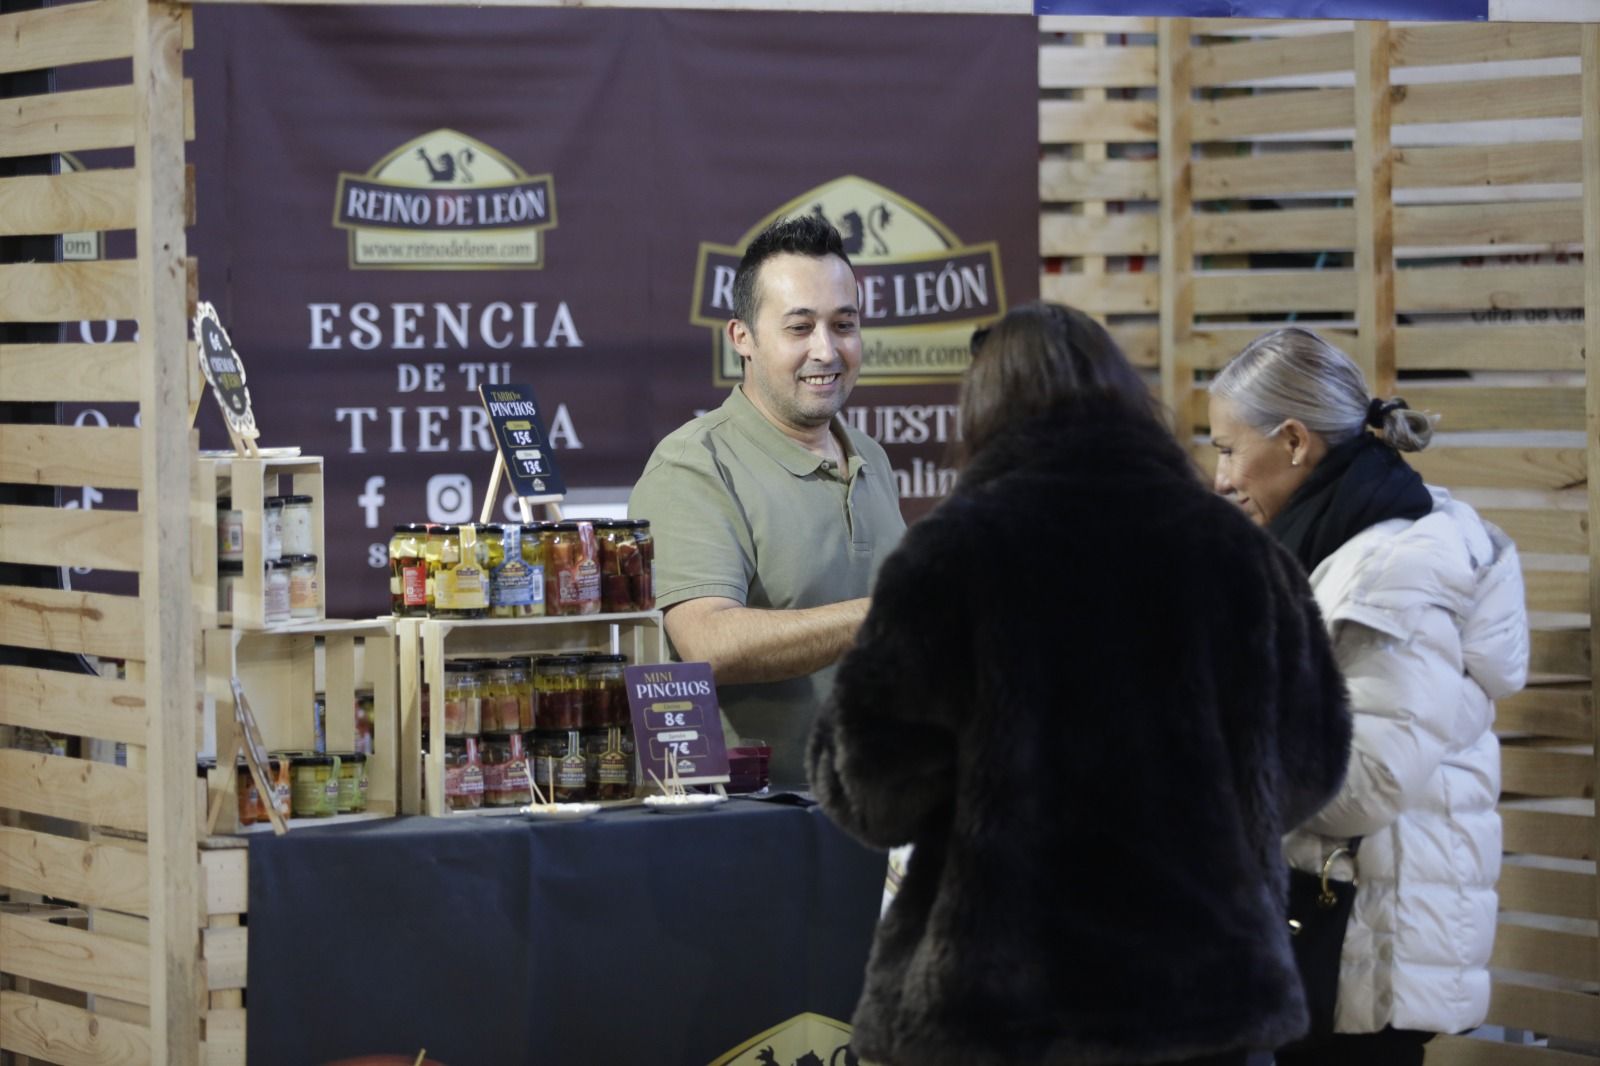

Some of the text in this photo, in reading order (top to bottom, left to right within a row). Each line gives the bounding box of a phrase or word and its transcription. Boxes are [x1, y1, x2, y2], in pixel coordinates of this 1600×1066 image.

[346, 187, 546, 226] REINO DE LEÓN
[893, 262, 990, 317] LEÓN
[306, 301, 585, 350] ESENCIA
[397, 363, 446, 393] DE
[490, 391, 514, 402] TARRO
[489, 401, 537, 417] PINCHOS
[335, 403, 585, 454] TIERA
[512, 431, 533, 446] 15€
[522, 460, 542, 475] 13€
[643, 671, 673, 684] MINI
[635, 680, 712, 700] PINCHOS
[664, 712, 686, 727] 8€
[669, 742, 691, 757] 7€
